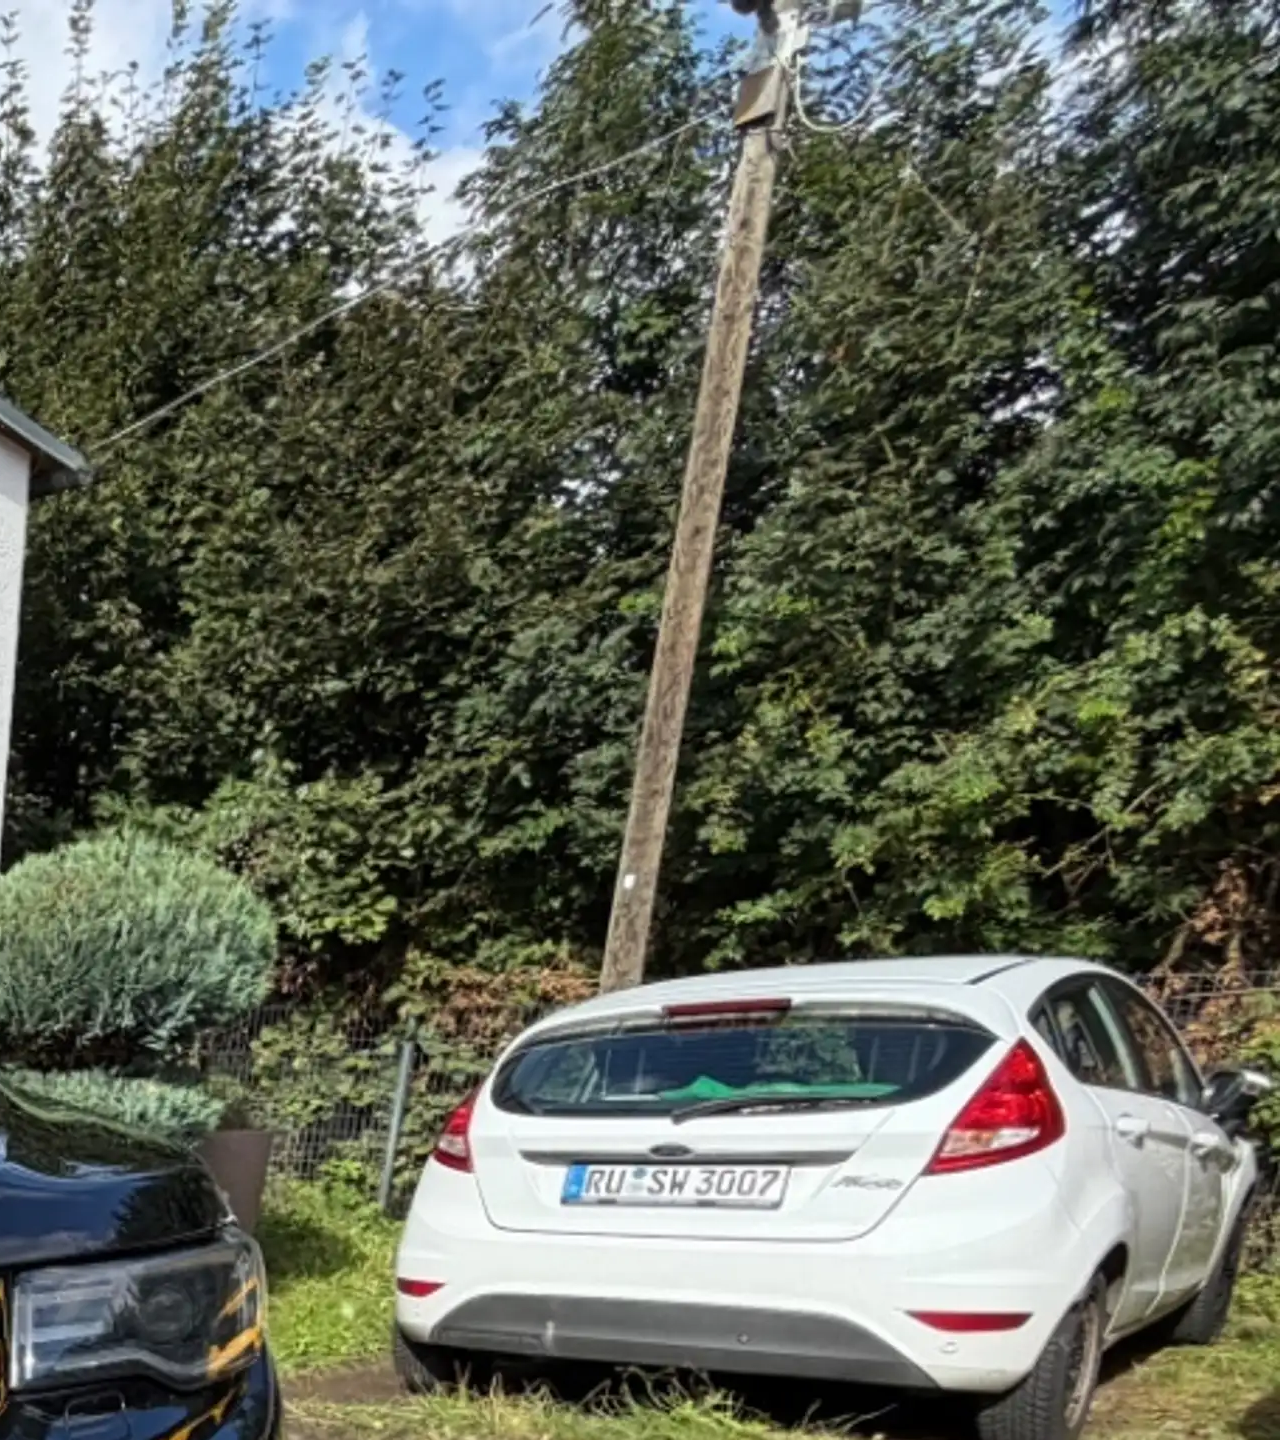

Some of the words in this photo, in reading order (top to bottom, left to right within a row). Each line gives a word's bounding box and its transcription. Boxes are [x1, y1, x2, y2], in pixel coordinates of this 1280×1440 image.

[584, 1168, 627, 1195] RU
[647, 1168, 692, 1196] SW
[694, 1169, 781, 1197] 3007
